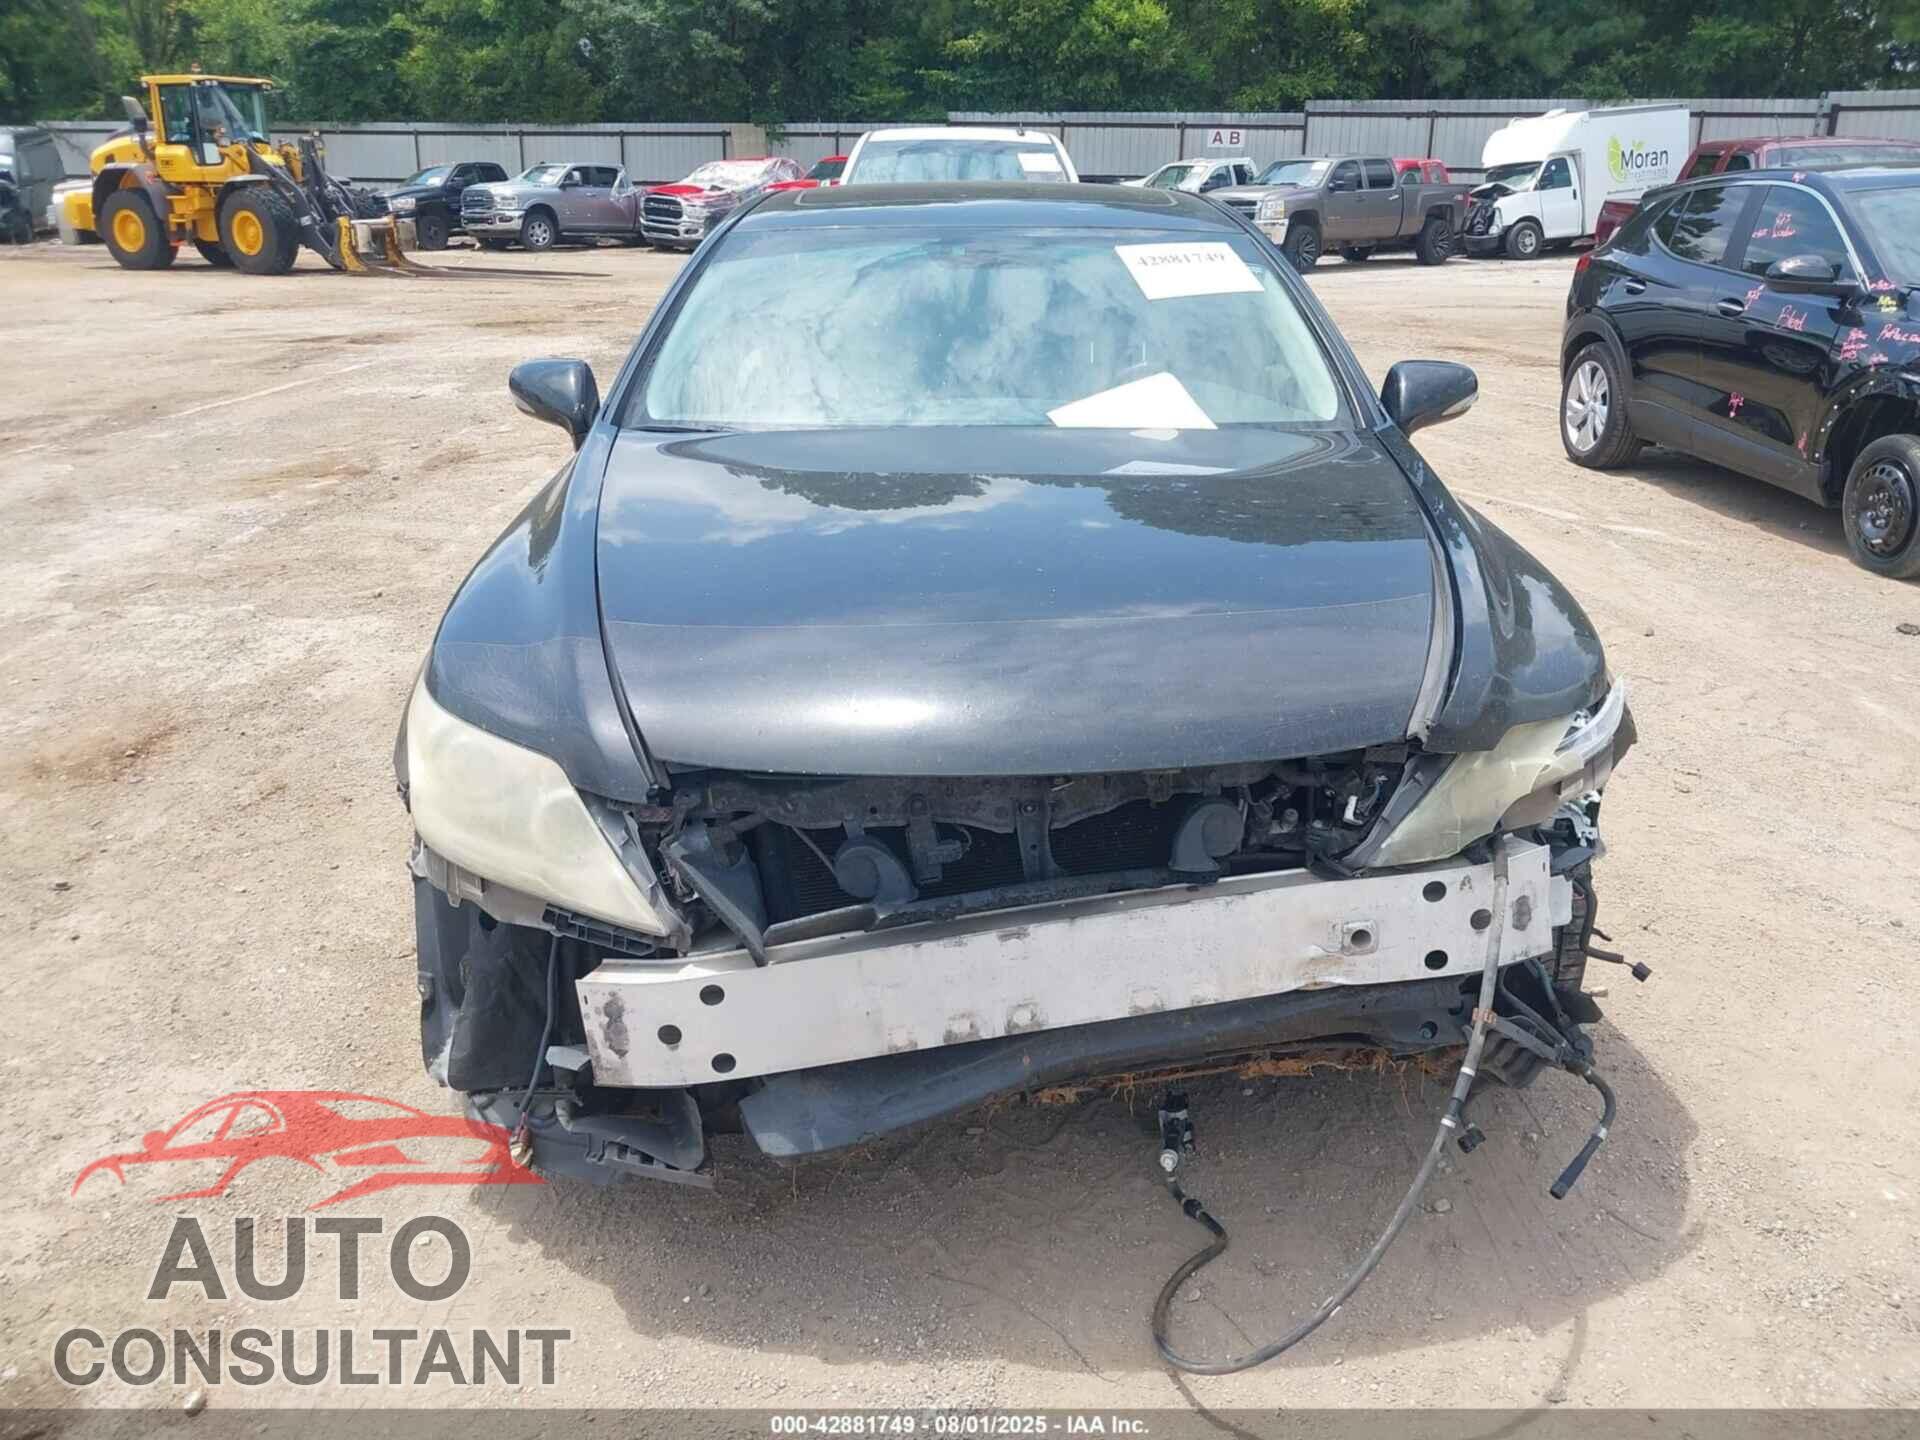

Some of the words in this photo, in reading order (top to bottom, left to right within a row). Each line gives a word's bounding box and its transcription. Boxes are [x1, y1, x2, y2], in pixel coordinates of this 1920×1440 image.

[1212, 131, 1223, 144] A
[1229, 131, 1240, 144] B
[1621, 149, 1669, 170] Moran
[1138, 252, 1226, 266] 42881749
